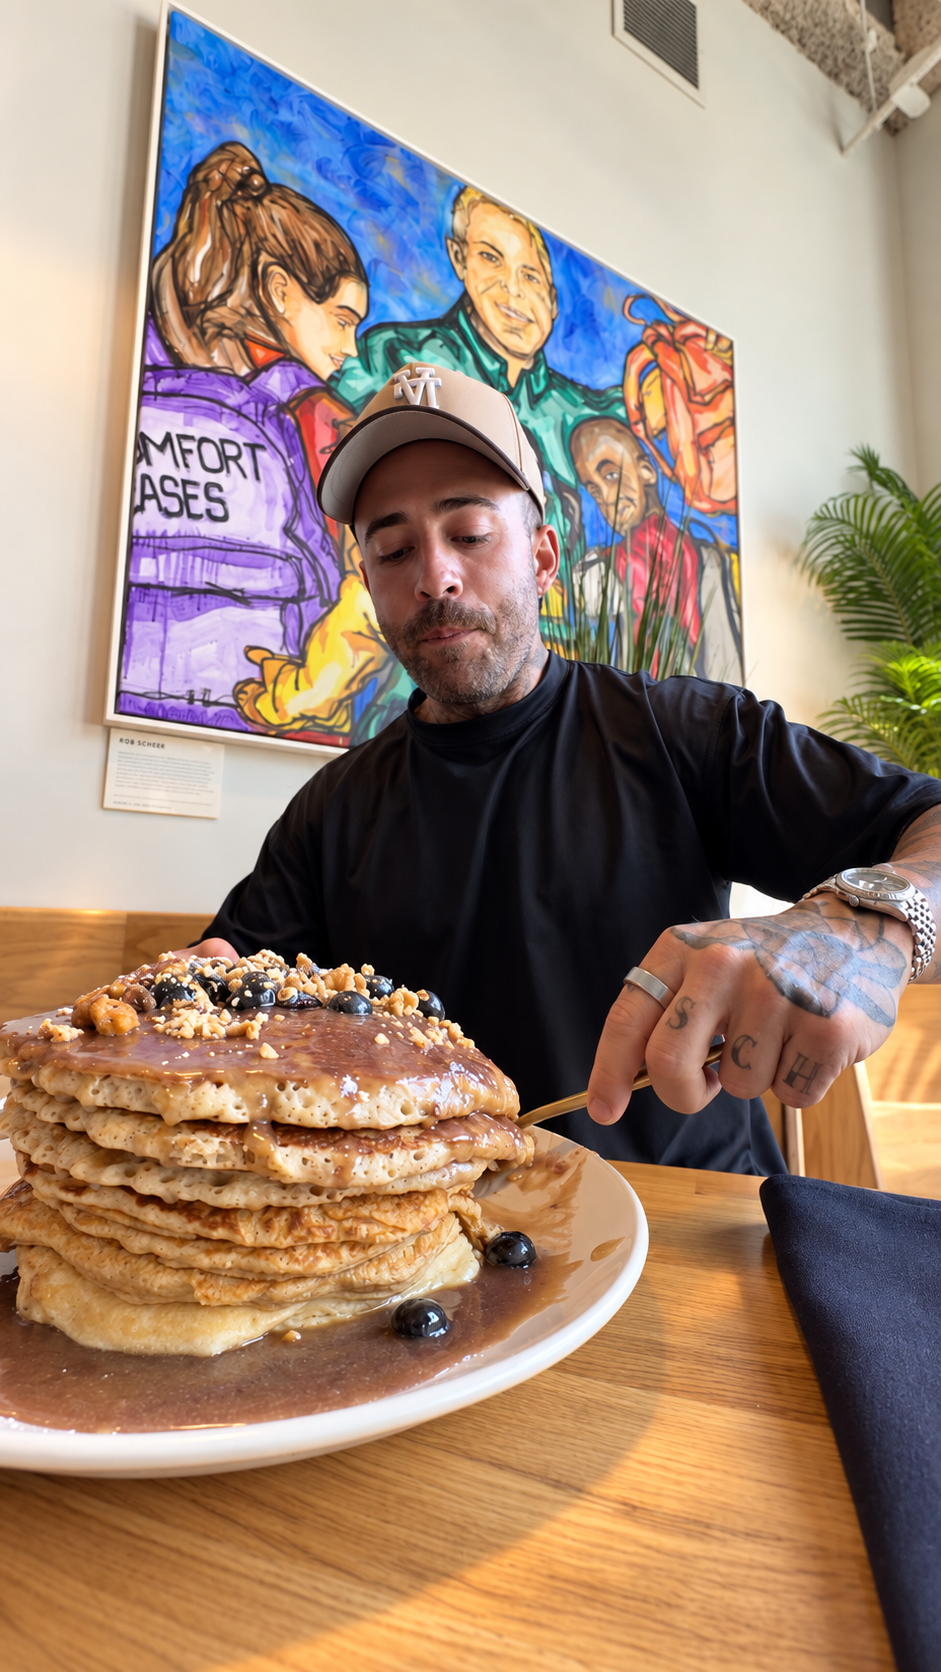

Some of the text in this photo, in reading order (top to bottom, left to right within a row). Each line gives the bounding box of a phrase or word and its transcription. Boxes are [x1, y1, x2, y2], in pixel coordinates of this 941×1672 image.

[133, 473, 229, 522] ASES
[119, 738, 165, 749] ROB SCHEER
